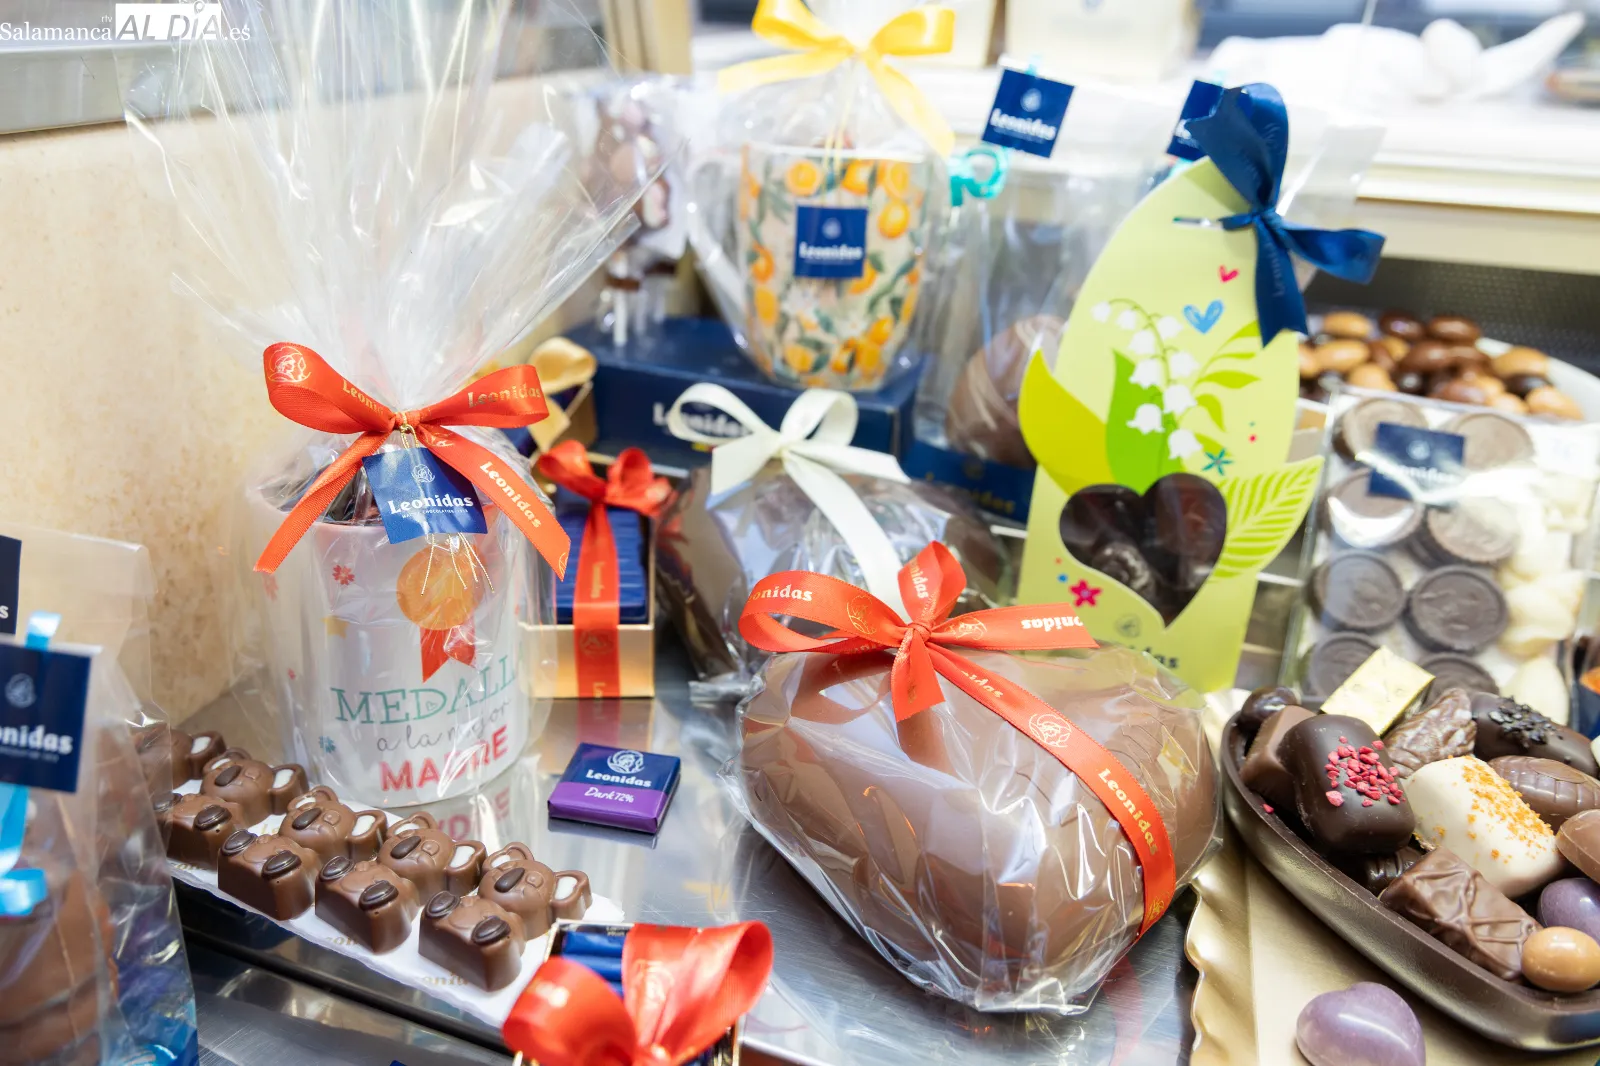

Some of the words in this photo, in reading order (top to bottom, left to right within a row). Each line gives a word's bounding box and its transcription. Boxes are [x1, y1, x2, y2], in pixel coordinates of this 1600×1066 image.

[467, 382, 542, 409] Leonidas
[387, 493, 474, 514] Leonidas
[480, 461, 542, 529] Leonidas
[585, 768, 653, 788] Leonidas
[584, 786, 615, 801] Dark
[1098, 767, 1159, 855] Leonidas
